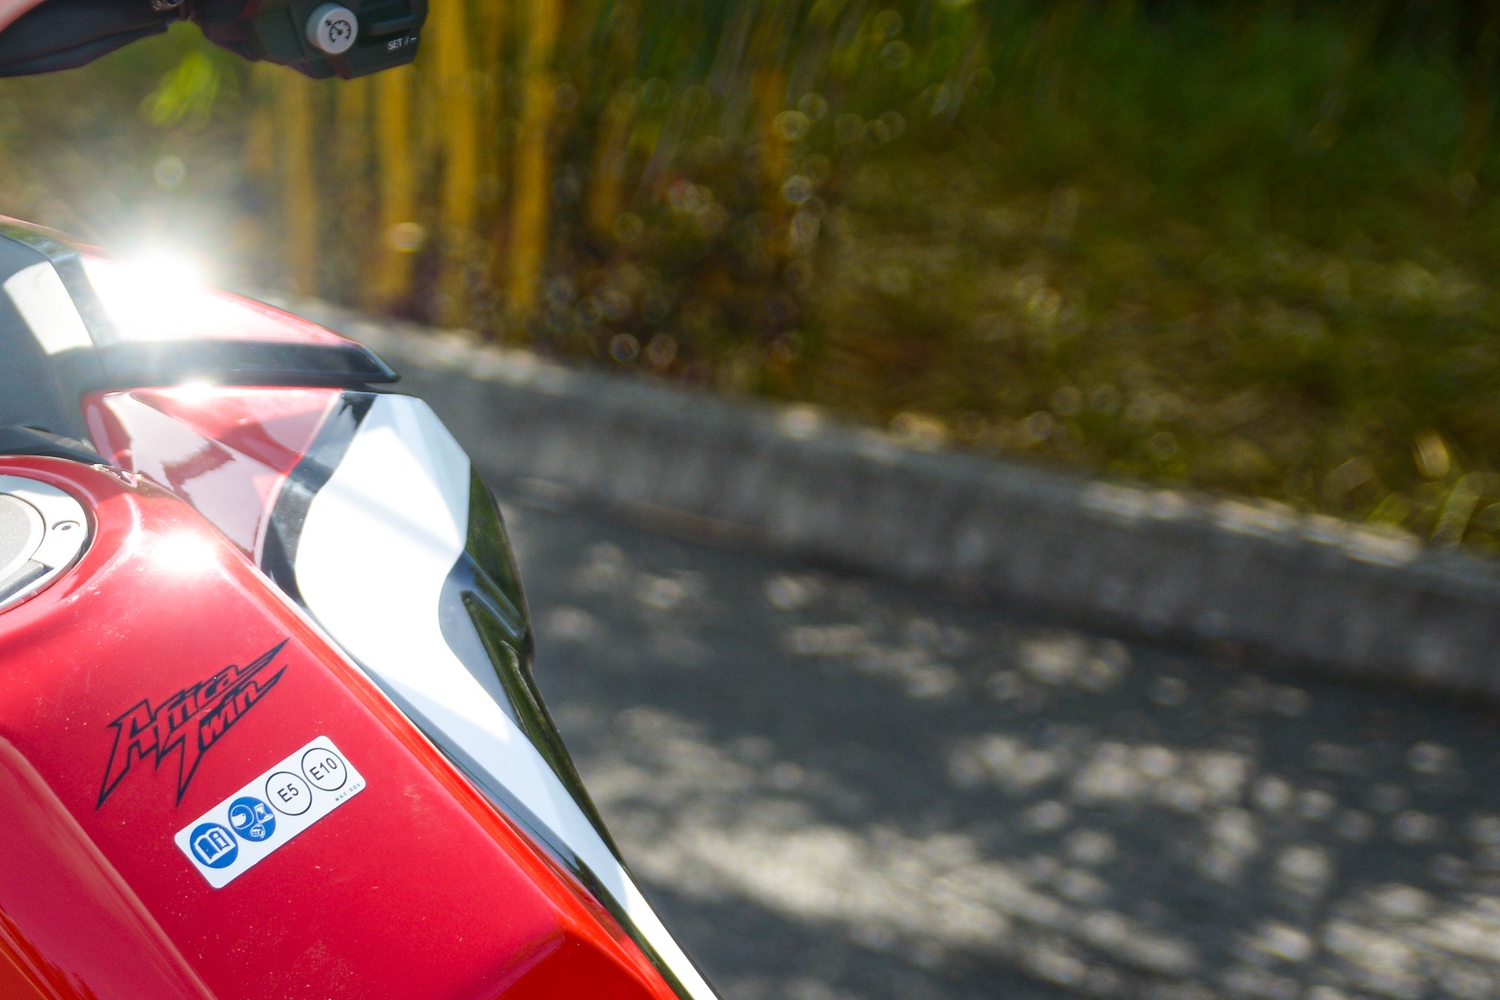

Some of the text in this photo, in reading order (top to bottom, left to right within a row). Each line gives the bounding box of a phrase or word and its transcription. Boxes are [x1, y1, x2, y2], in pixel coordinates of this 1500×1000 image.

[97, 637, 291, 810] Africa
[159, 664, 289, 807] Twin
[277, 783, 299, 804] E5
[309, 757, 338, 781] E10
